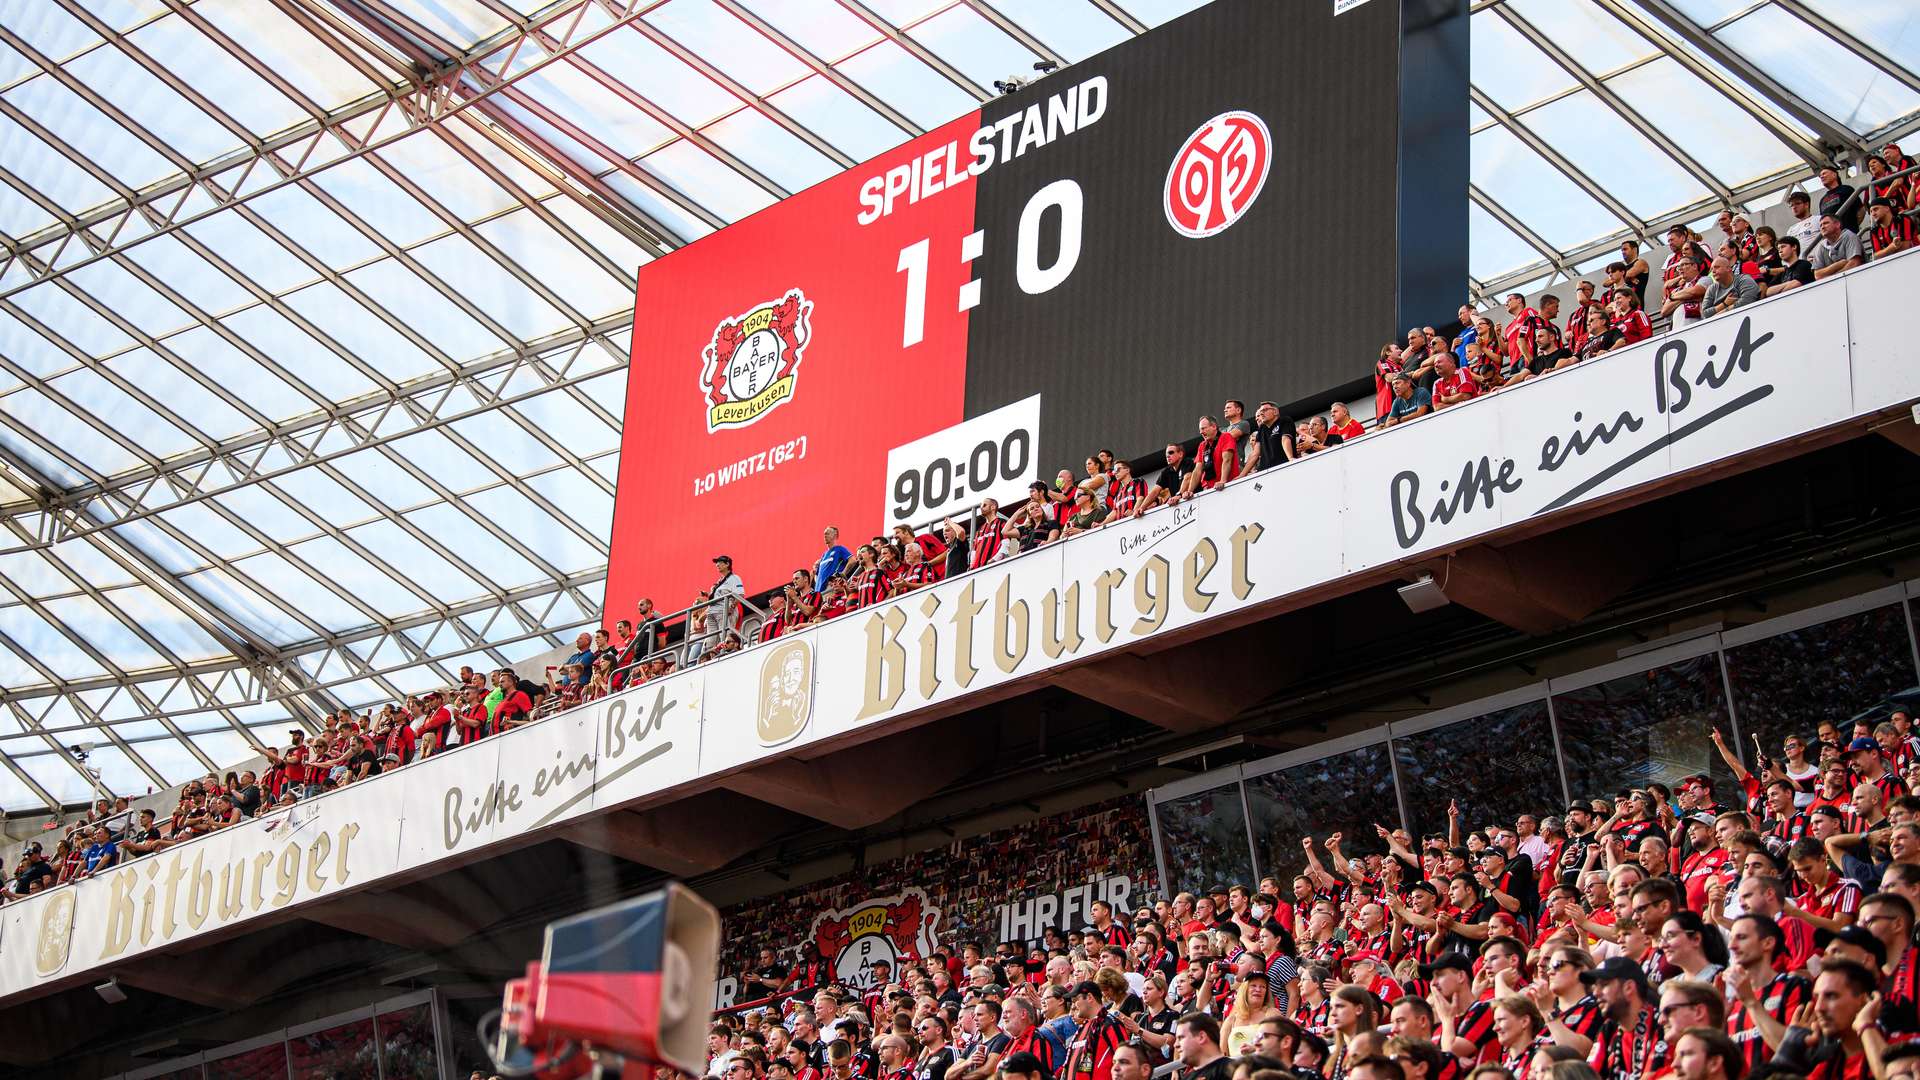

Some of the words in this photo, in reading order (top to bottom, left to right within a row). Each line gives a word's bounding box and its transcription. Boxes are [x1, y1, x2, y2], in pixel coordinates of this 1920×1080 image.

[857, 75, 1108, 226] SPIELSTAND
[745, 312, 769, 333] 1904
[733, 351, 776, 378] BAYER
[748, 335, 761, 395] BAYER
[716, 383, 786, 421] Leverkusen
[1390, 455, 1523, 549] Bitte
[1537, 410, 1644, 472] ein
[1654, 315, 1775, 414] Bit
[694, 472, 716, 497] 1:0
[717, 451, 766, 488] WIRTZ
[893, 428, 1030, 520] 90:00
[1120, 532, 1147, 555] Bitte
[1152, 525, 1171, 538] ein
[1173, 504, 1198, 526] Bit
[854, 521, 1266, 721] Bitburger
[443, 779, 523, 851] Bitte
[532, 750, 597, 796] ein
[605, 685, 678, 759] Bit
[98, 821, 361, 960] Bitburger
[852, 912, 883, 933] 1904
[1000, 894, 1058, 943] IHR
[1062, 872, 1132, 932] FÜR
